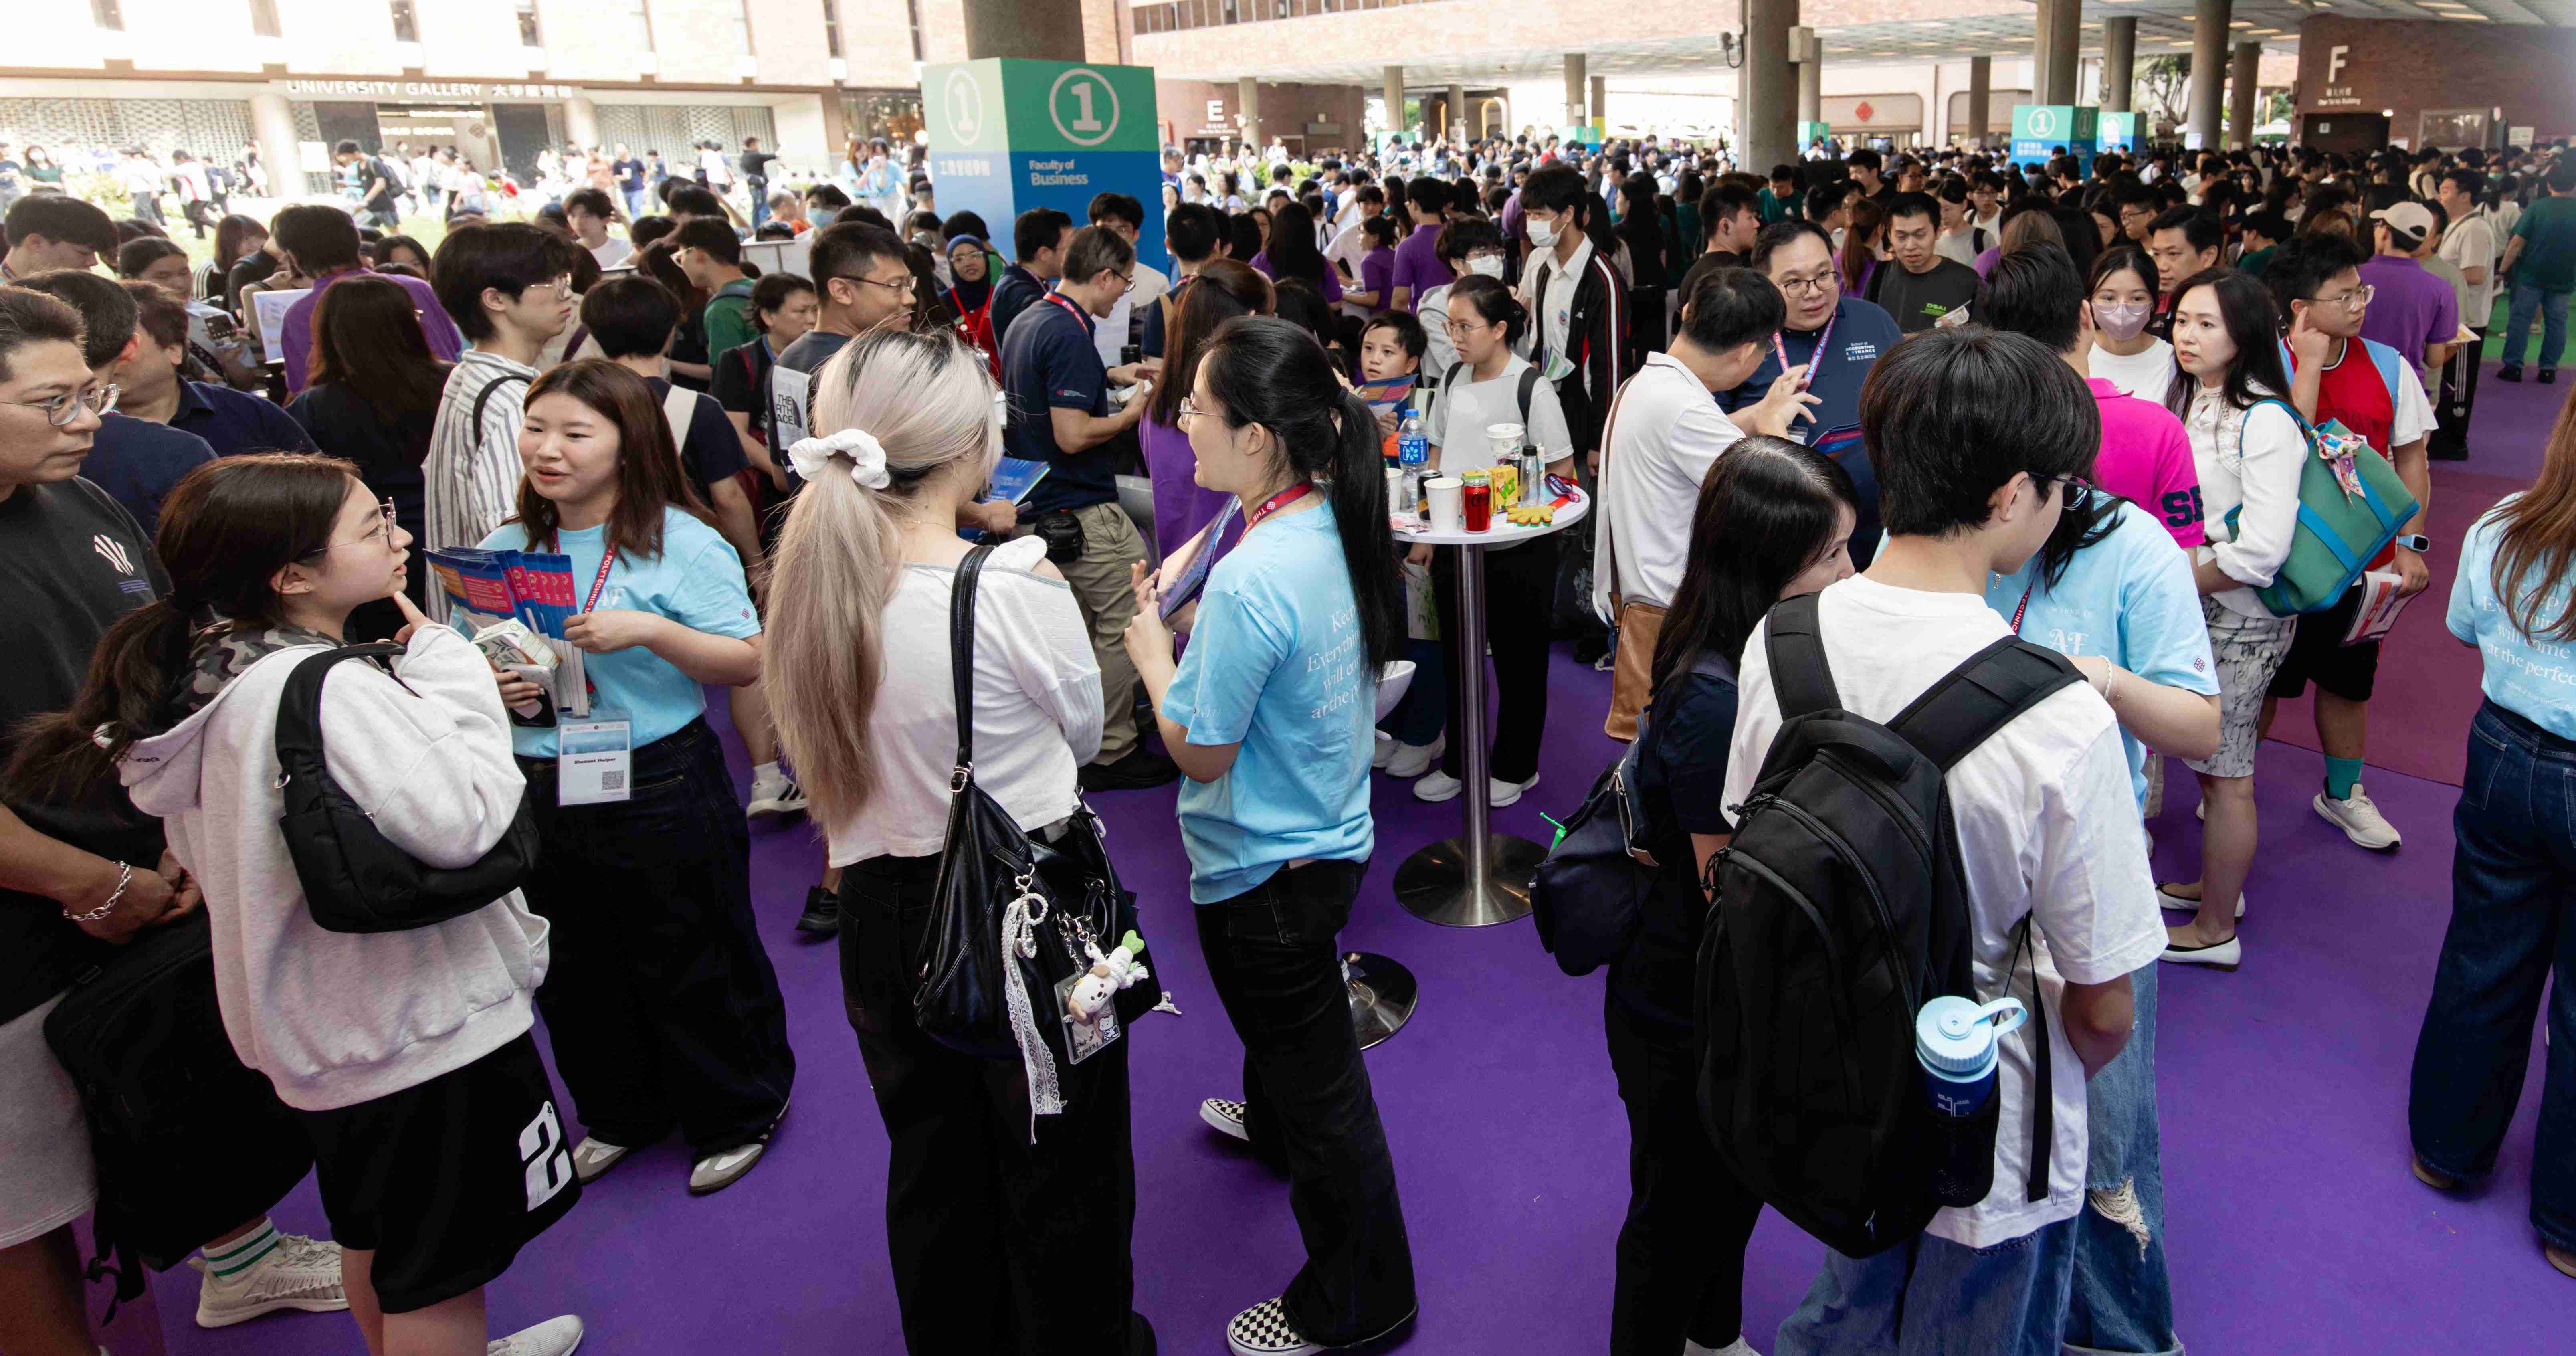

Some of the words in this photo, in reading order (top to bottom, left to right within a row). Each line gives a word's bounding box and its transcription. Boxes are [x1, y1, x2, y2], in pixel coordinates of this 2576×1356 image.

[2328, 45, 2348, 83] F
[286, 80, 398, 95] UNIVERSITY
[406, 82, 481, 97] GALLERY
[1207, 100, 1225, 121] E
[1029, 160, 1063, 172] Faculty
[1065, 159, 1075, 170] of
[1030, 172, 1088, 186] Business
[778, 394, 793, 405] THE
[777, 414, 794, 425] ACE
[1253, 507, 1267, 522] THE
[588, 555, 613, 606] POLYTECHNIC
[2049, 628, 2089, 655] AF
[2487, 643, 2500, 658] at
[2501, 649, 2524, 667] the
[2525, 661, 2576, 686] perfec
[1323, 663, 1343, 691] will
[1311, 704, 1328, 719] at
[1329, 691, 1350, 712] the
[519, 1101, 572, 1212] 2
